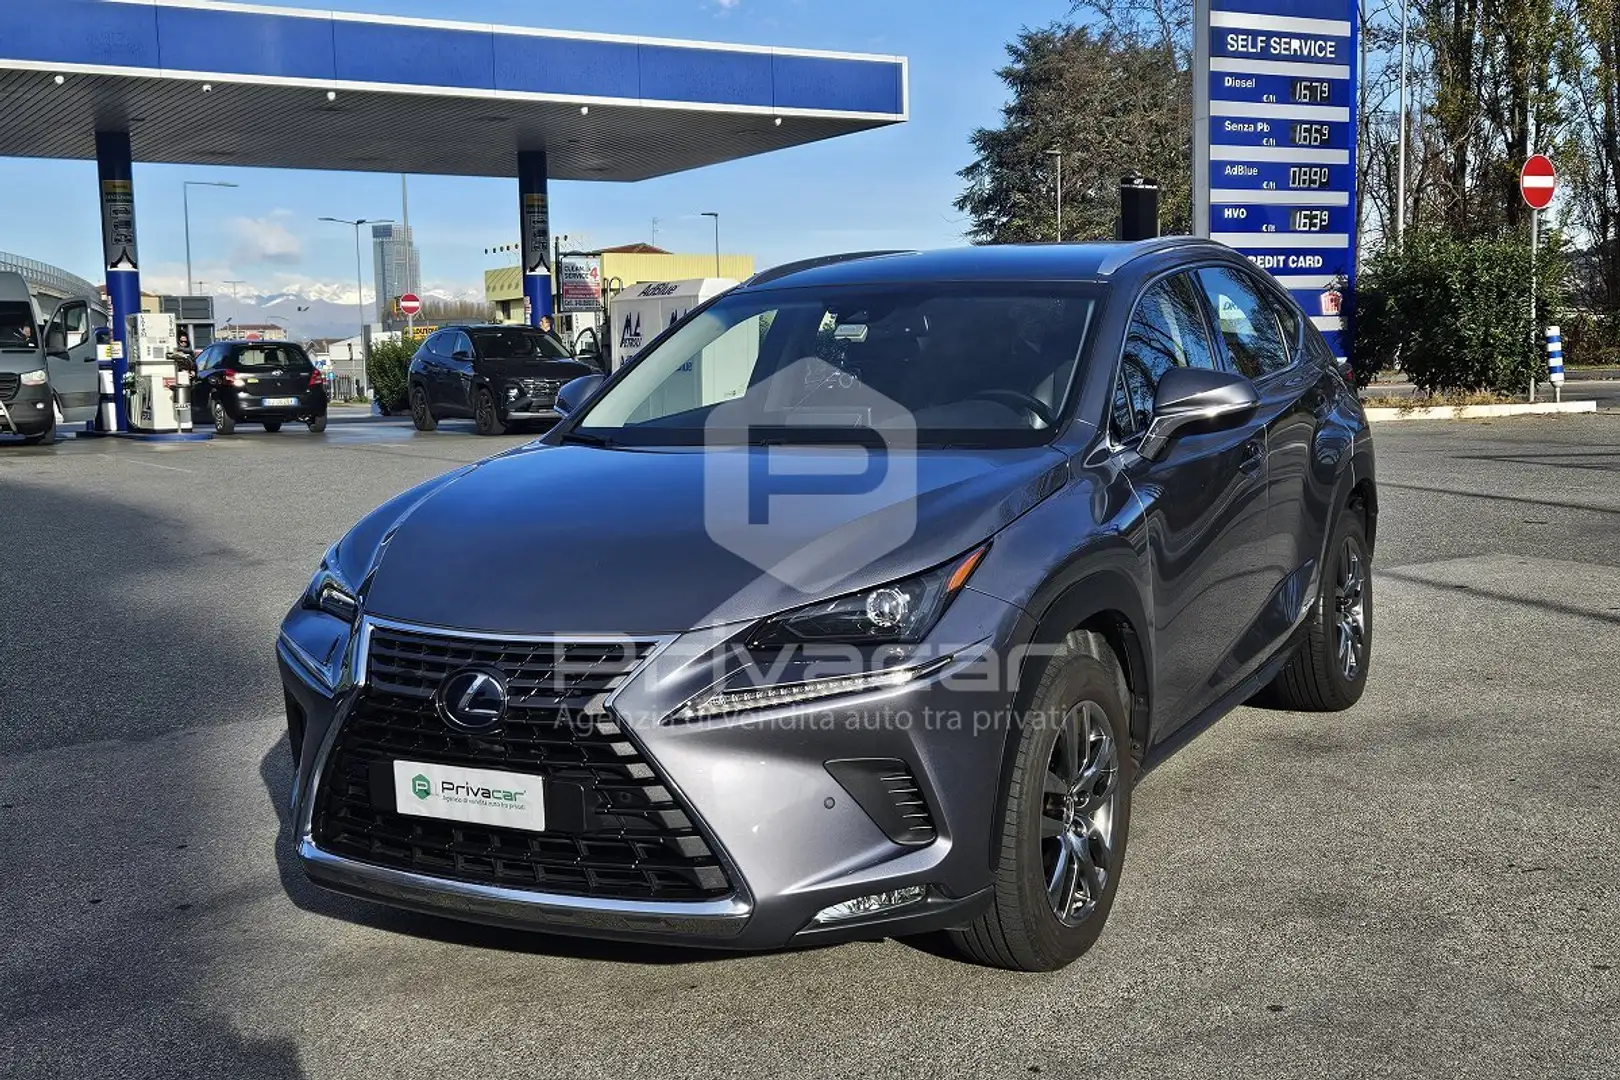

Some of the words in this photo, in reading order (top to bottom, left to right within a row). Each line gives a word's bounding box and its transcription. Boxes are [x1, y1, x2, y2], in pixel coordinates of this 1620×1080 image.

[1227, 34, 1266, 53] SELF
[1270, 37, 1336, 58] SERVICE
[1224, 76, 1256, 88] Diesel
[1224, 120, 1254, 132] Senza
[1257, 122, 1271, 132] Pb
[1224, 164, 1259, 176] AdBlue
[1224, 207, 1247, 219] HVO
[1246, 255, 1286, 269] REDIT
[1288, 255, 1323, 269] CARD
[589, 266, 599, 280] 4
[637, 282, 678, 297] AdBlue
[441, 781, 525, 802] Privacar
